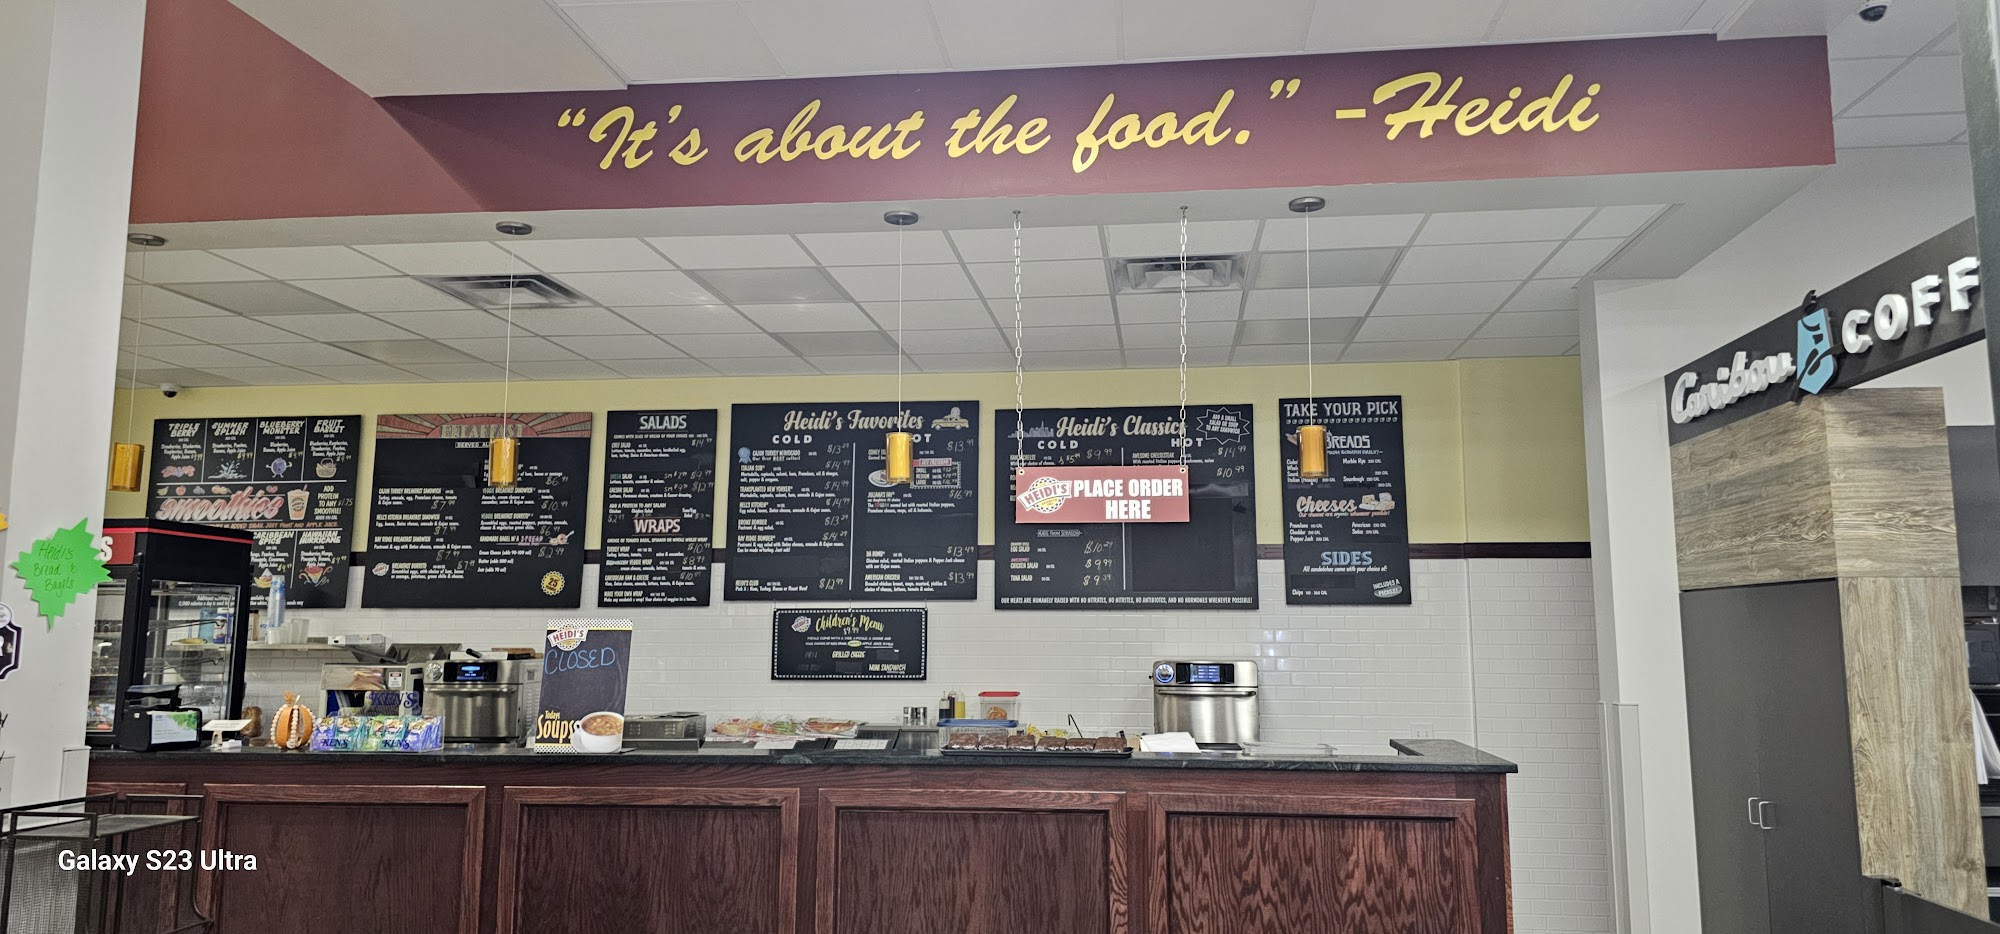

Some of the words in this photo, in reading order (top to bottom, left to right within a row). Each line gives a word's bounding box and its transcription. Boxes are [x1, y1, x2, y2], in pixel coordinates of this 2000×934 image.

[733, 99, 925, 164] about
[945, 94, 1052, 158] the
[1670, 350, 1797, 424] Caribou
[1284, 403, 1318, 417] TAKE
[1322, 402, 1362, 416] YOUR
[1366, 401, 1398, 415] PICK
[212, 422, 249, 430] SUMMER
[315, 419, 343, 428] FRUIT
[639, 415, 688, 430] SALADS
[783, 410, 844, 431] Heidi's
[847, 409, 924, 430] Favorites
[169, 423, 201, 431] TRIPLE
[170, 429, 198, 438] BERRY
[214, 428, 246, 436] SPLASH
[262, 427, 301, 435] MONSTER
[314, 426, 345, 434] BASKET
[441, 424, 525, 438] BREAKFAST
[1056, 416, 1119, 438] Heidi's
[1220, 426, 1241, 434] SANDWICH
[772, 435, 813, 444] COLD
[1037, 440, 1080, 450] COLD
[1171, 437, 1204, 448] HOT
[1327, 435, 1371, 448] BREADS
[1074, 479, 1127, 497] PLACE
[1128, 478, 1183, 496] ORDER
[1024, 484, 1068, 506] HEIDI'S
[155, 486, 285, 521] smoothies
[1105, 499, 1152, 519] HERE
[1296, 495, 1357, 512] Cheeses
[634, 518, 681, 533] WRAPS
[299, 537, 341, 545] HURRICANE
[1320, 551, 1373, 566] SIDES
[33, 563, 61, 577] Bread
[948, 572, 975, 584] $13.99
[44, 577, 75, 597] Bagels
[1372, 580, 1396, 590] INCLUDES
[815, 613, 857, 632] Children's
[859, 614, 885, 632] Menu
[552, 629, 585, 642] HEIDI'S
[544, 646, 615, 675] CLOSED
[832, 650, 850, 658] GRILLED
[880, 663, 906, 672] SANDWICH
[369, 691, 416, 709] KEN'S
[536, 714, 575, 744] Soups
[321, 738, 349, 748] KEN'S
[381, 738, 410, 749] KEN'S
